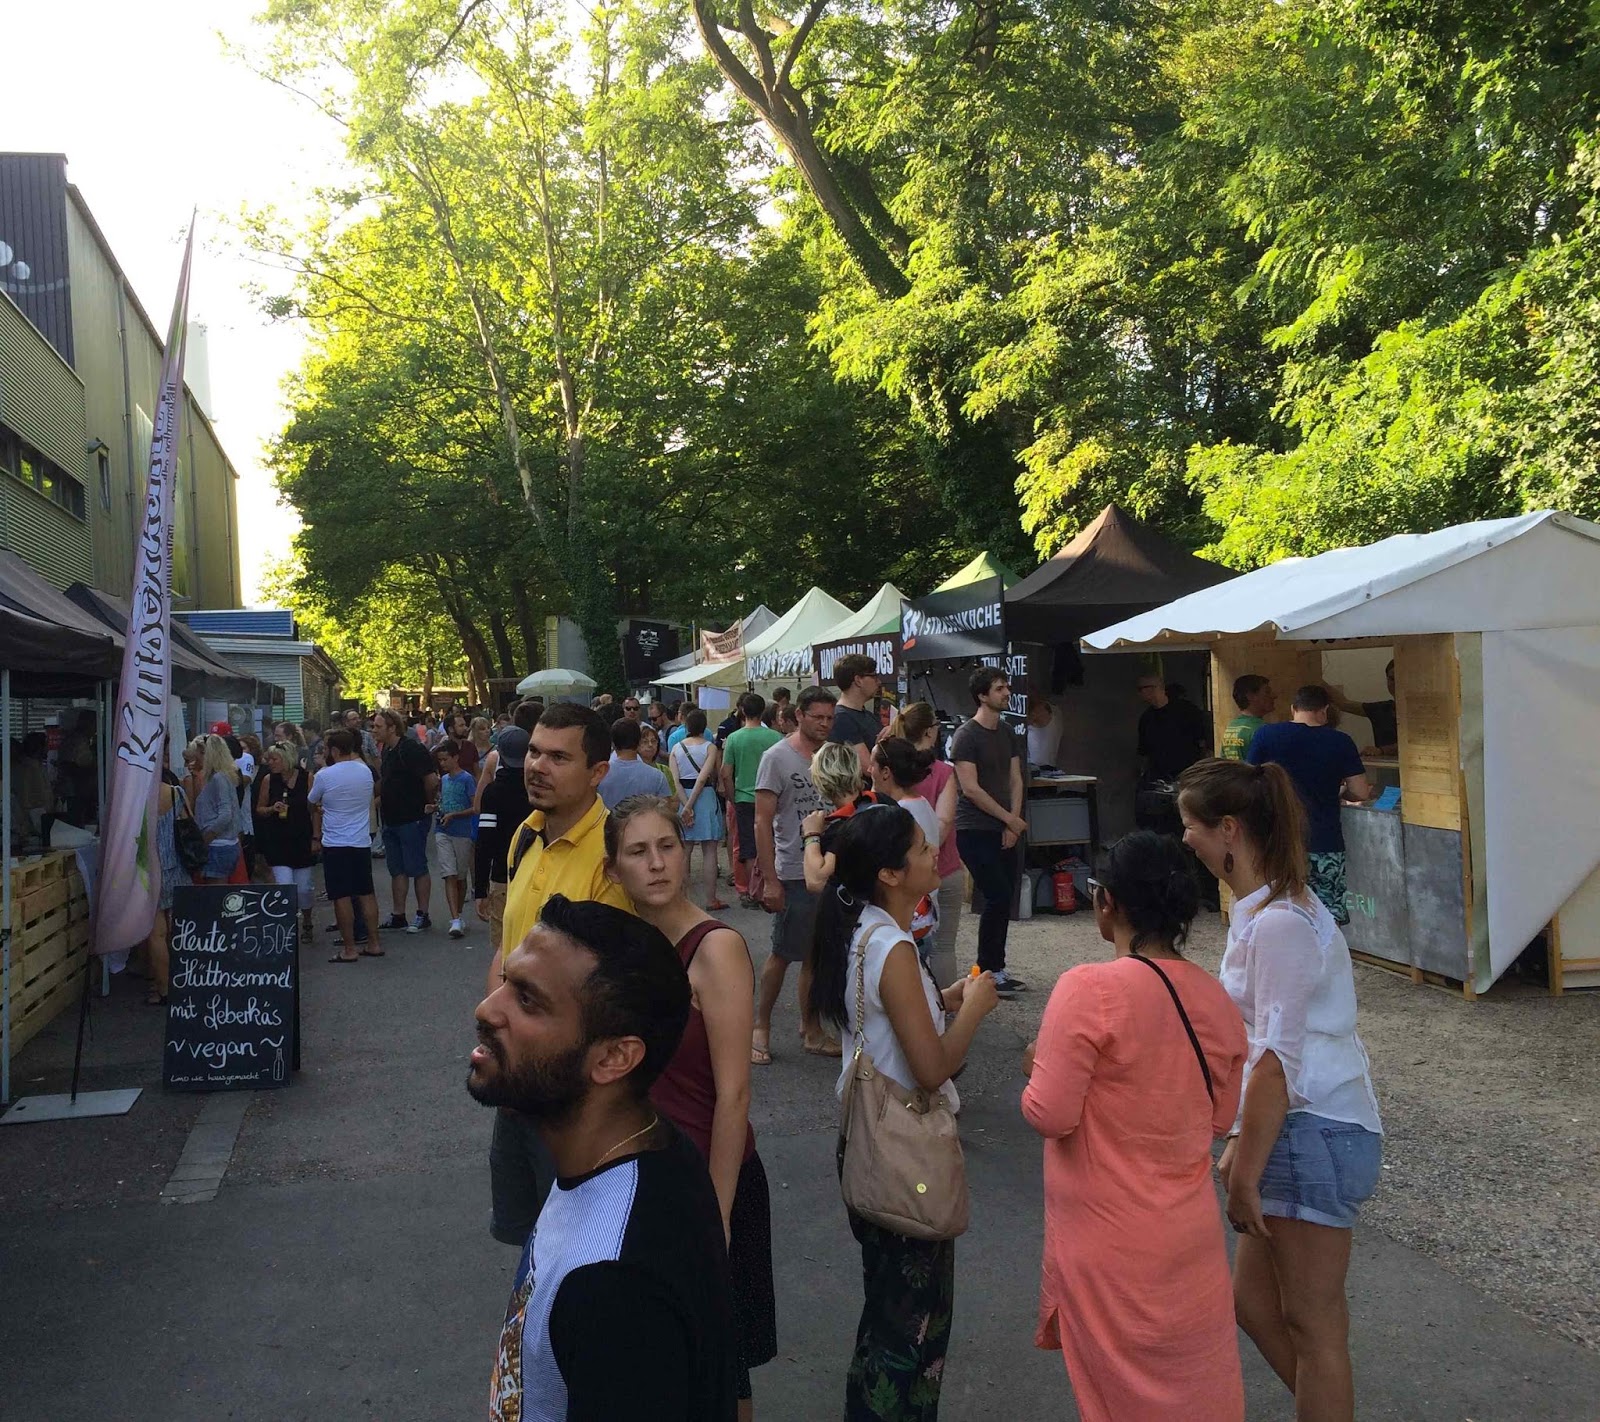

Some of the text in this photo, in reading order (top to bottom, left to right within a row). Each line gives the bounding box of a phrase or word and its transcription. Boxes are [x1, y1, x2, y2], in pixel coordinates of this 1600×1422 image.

[171, 918, 296, 957] Heute: 5,50€
[172, 957, 292, 989] Hüttnsemmel
[170, 994, 282, 1031] mit Leberkäs
[188, 1040, 258, 1069] vegan
